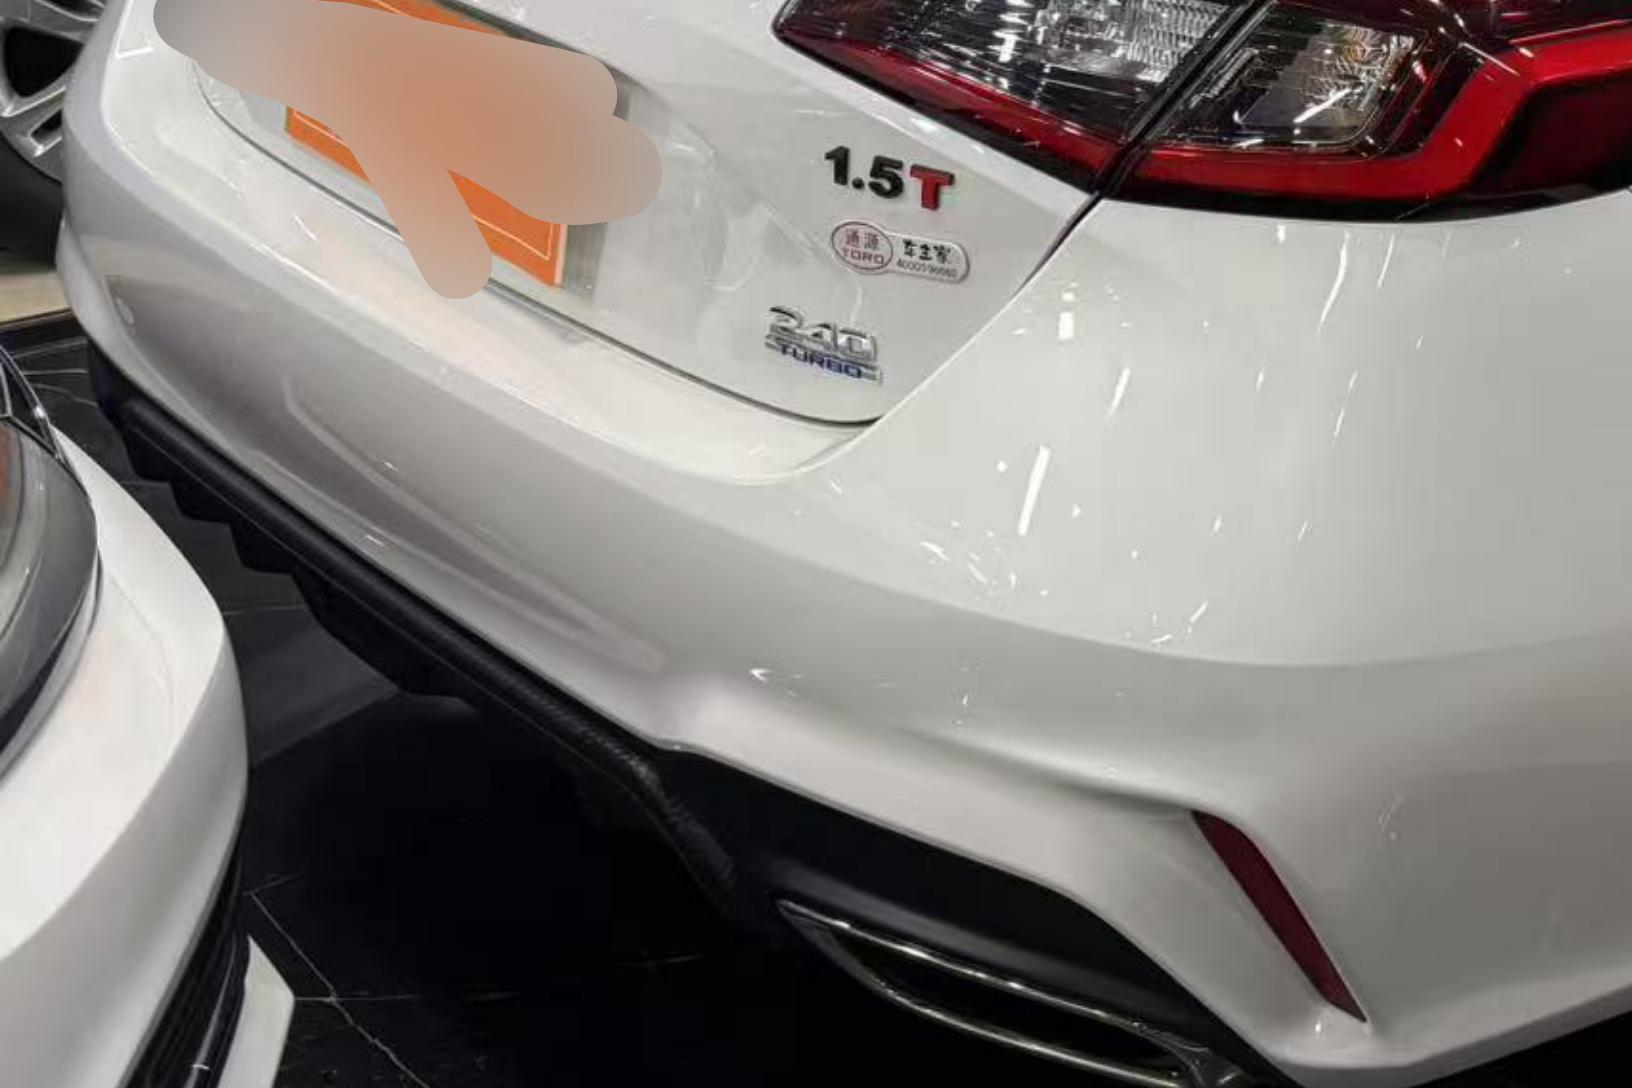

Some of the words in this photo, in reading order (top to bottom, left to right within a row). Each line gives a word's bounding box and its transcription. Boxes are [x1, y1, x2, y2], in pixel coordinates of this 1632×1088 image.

[824, 145, 956, 211] 1.5T
[768, 306, 878, 362] 240
[778, 342, 862, 380] TURBO
